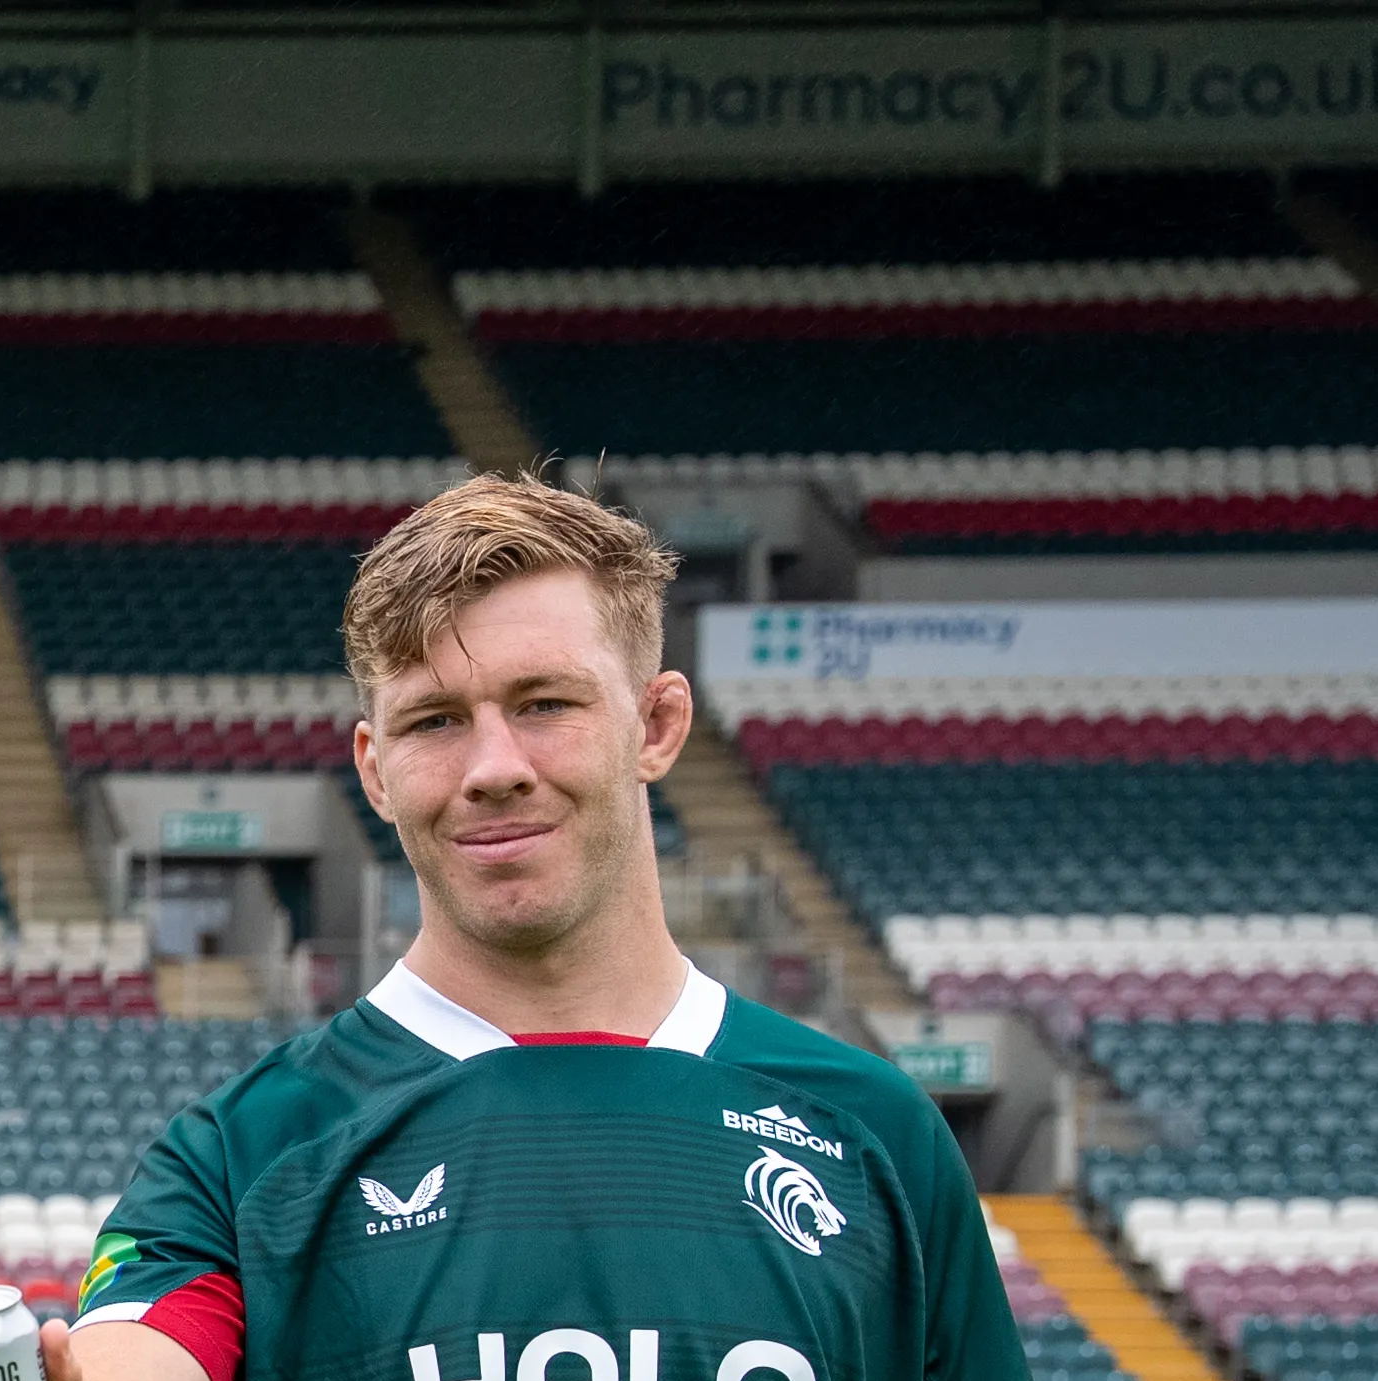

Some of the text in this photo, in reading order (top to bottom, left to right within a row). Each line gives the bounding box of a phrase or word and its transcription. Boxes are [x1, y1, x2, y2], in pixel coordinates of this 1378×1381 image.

[814, 610, 1020, 652] Pharmacy
[723, 1109, 843, 1160] BREEDON
[366, 1206, 447, 1236] CASTORE
